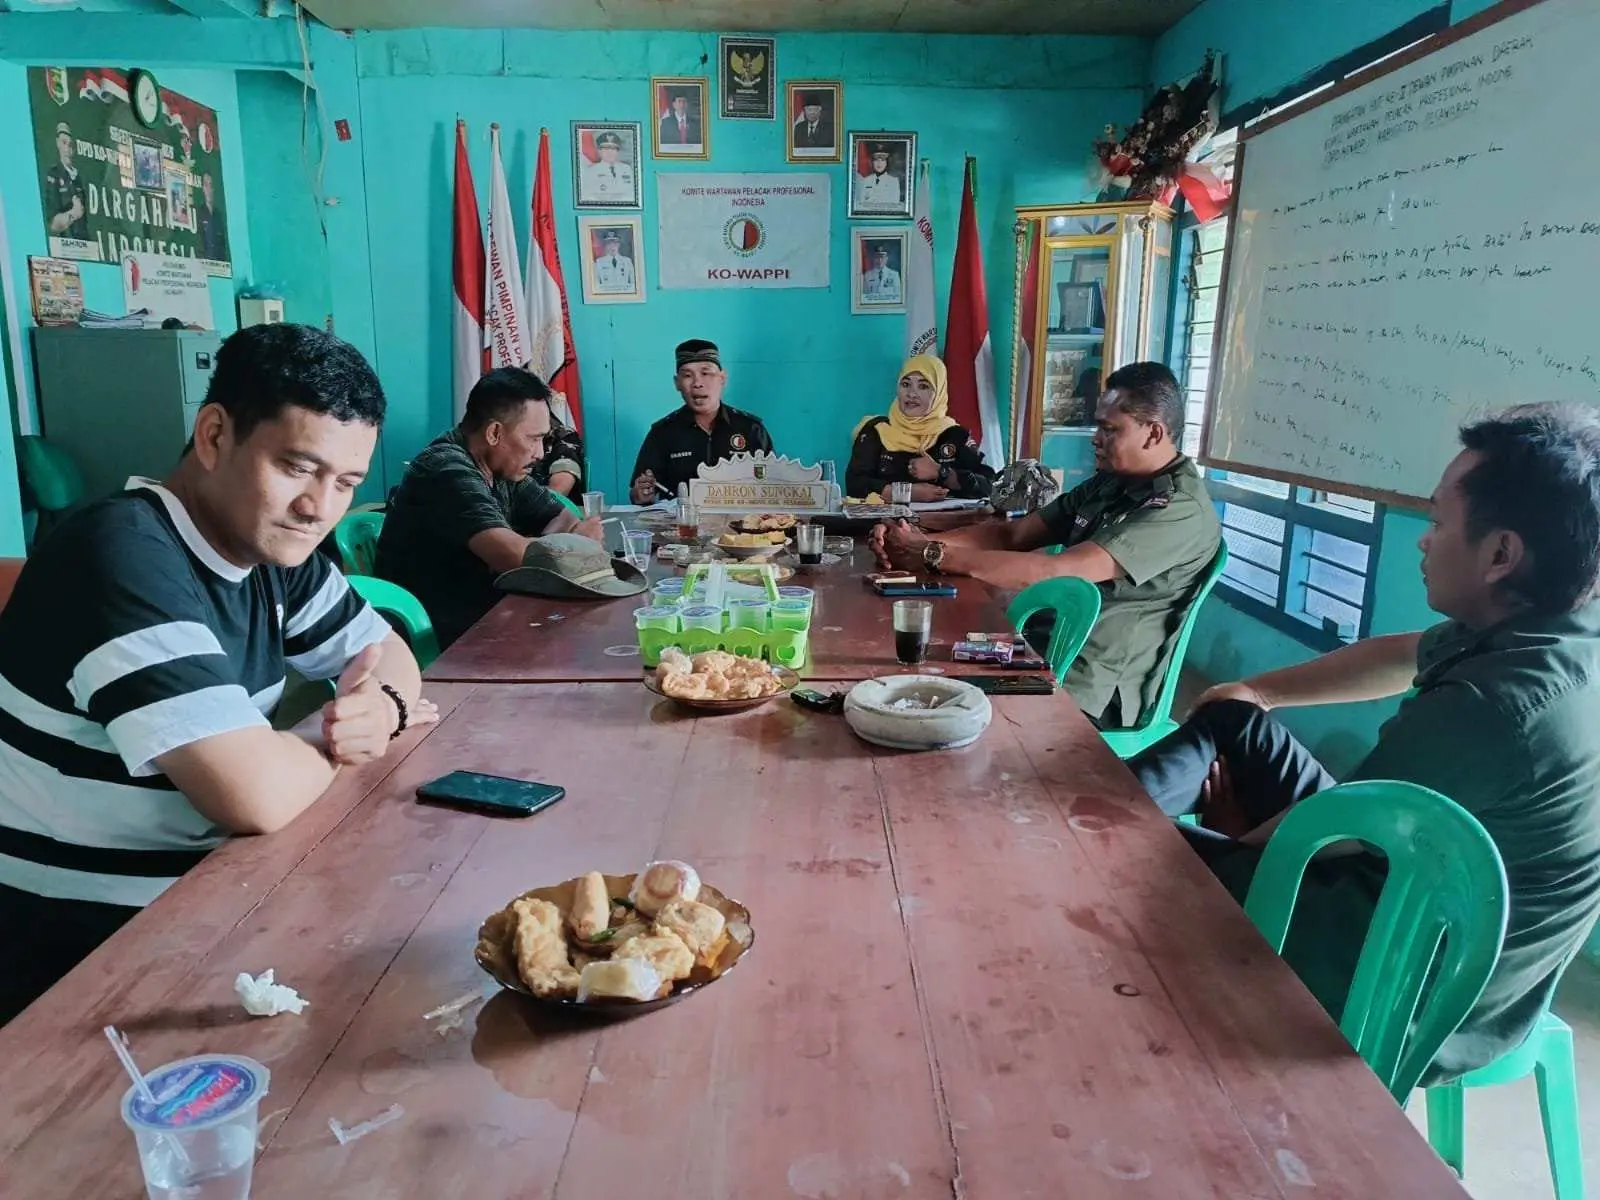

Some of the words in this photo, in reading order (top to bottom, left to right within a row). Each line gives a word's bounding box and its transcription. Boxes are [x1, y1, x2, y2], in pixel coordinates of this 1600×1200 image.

[681, 187, 704, 196] KOMITE
[706, 187, 741, 196] WARTAWAN
[742, 186, 770, 196] PELACAK
[772, 186, 814, 195] PROFESIONAL
[731, 198, 765, 206] INDONESIA
[88, 183, 198, 234] DIRGAHU
[707, 268, 790, 280] KO-WAPPI
[496, 280, 521, 344] PIMPINAN
[707, 485, 757, 498] DAHRON
[760, 485, 813, 498] SUNGKAI
